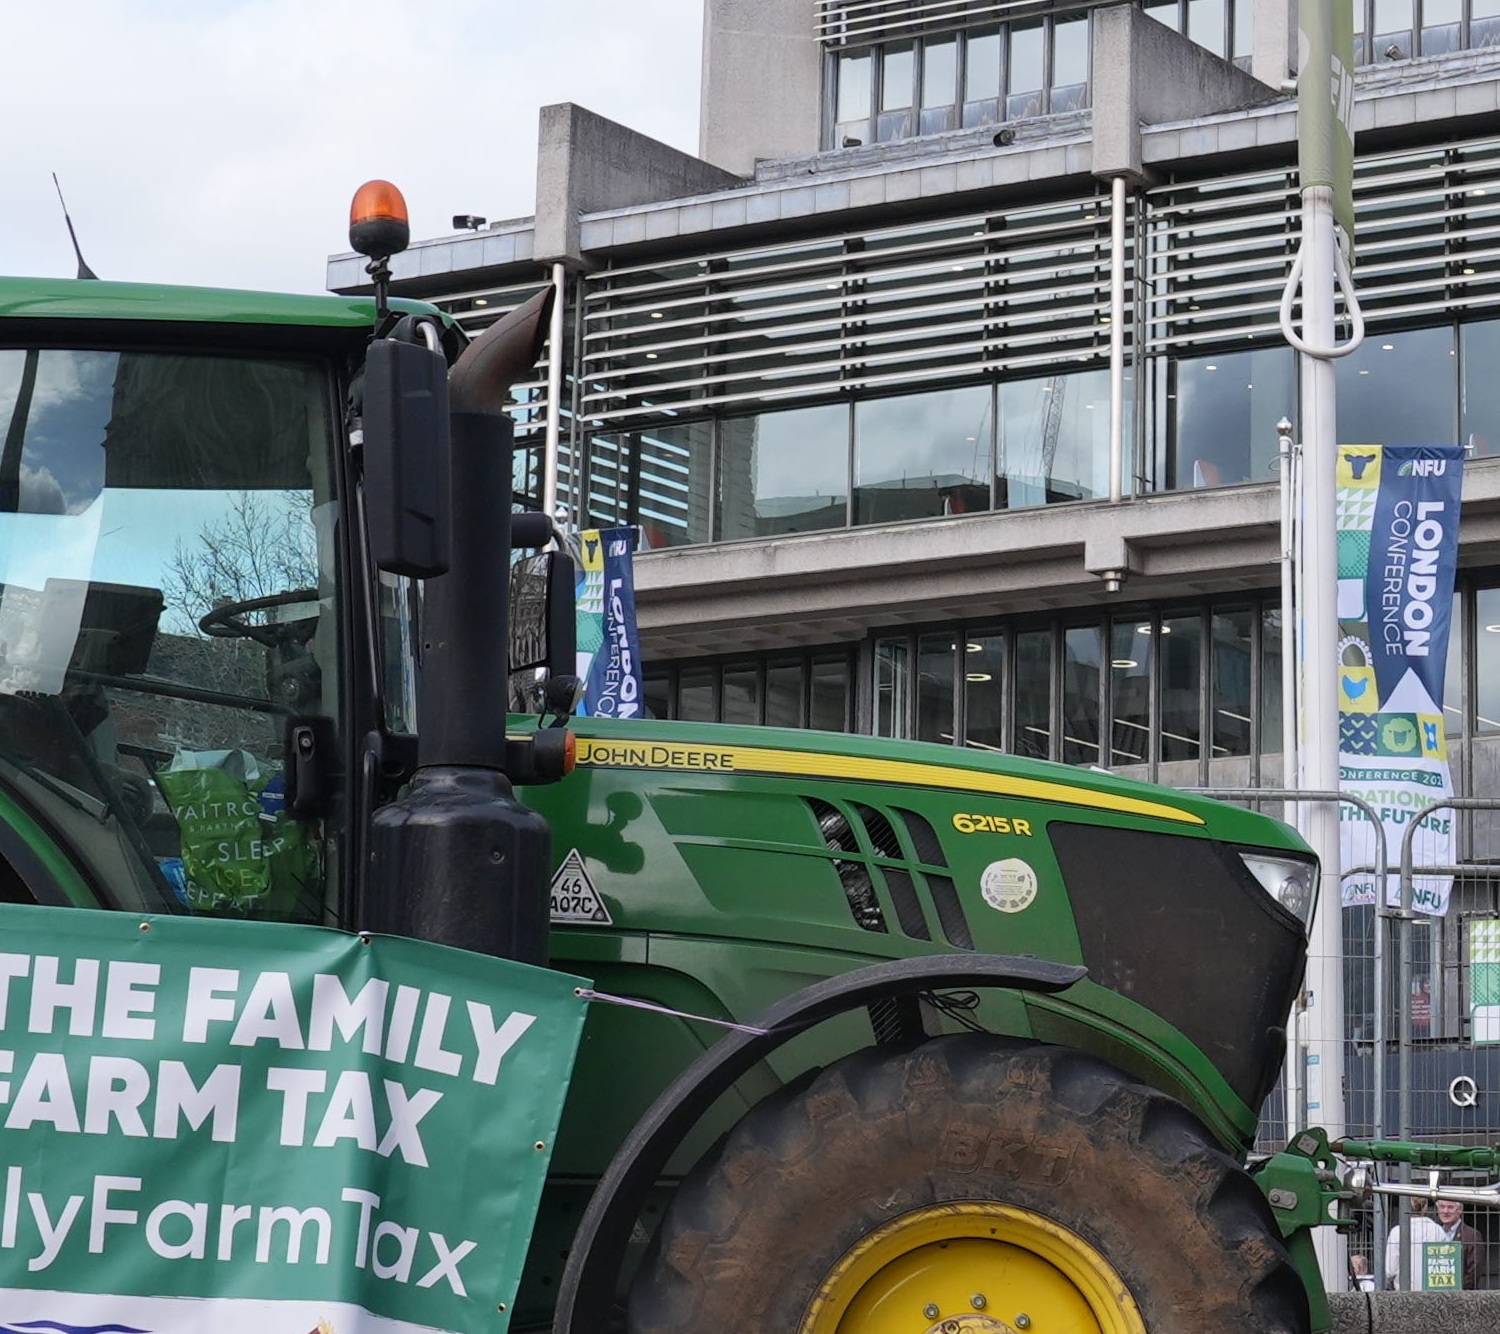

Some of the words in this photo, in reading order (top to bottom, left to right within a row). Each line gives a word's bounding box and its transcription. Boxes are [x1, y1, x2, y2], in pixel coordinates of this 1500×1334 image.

[1411, 459, 1447, 477] NFU
[1382, 500, 1413, 656] CONFERENCE
[1402, 501, 1445, 657] LONDON
[578, 744, 646, 765] JOHN
[651, 747, 735, 768] DEERE
[1339, 769, 1418, 782] ONFERENCE
[560, 878, 582, 895] 46
[182, 967, 538, 1086] FAMILY
[266, 1067, 445, 1168] TAX
[1428, 1275, 1456, 1286] TAX
